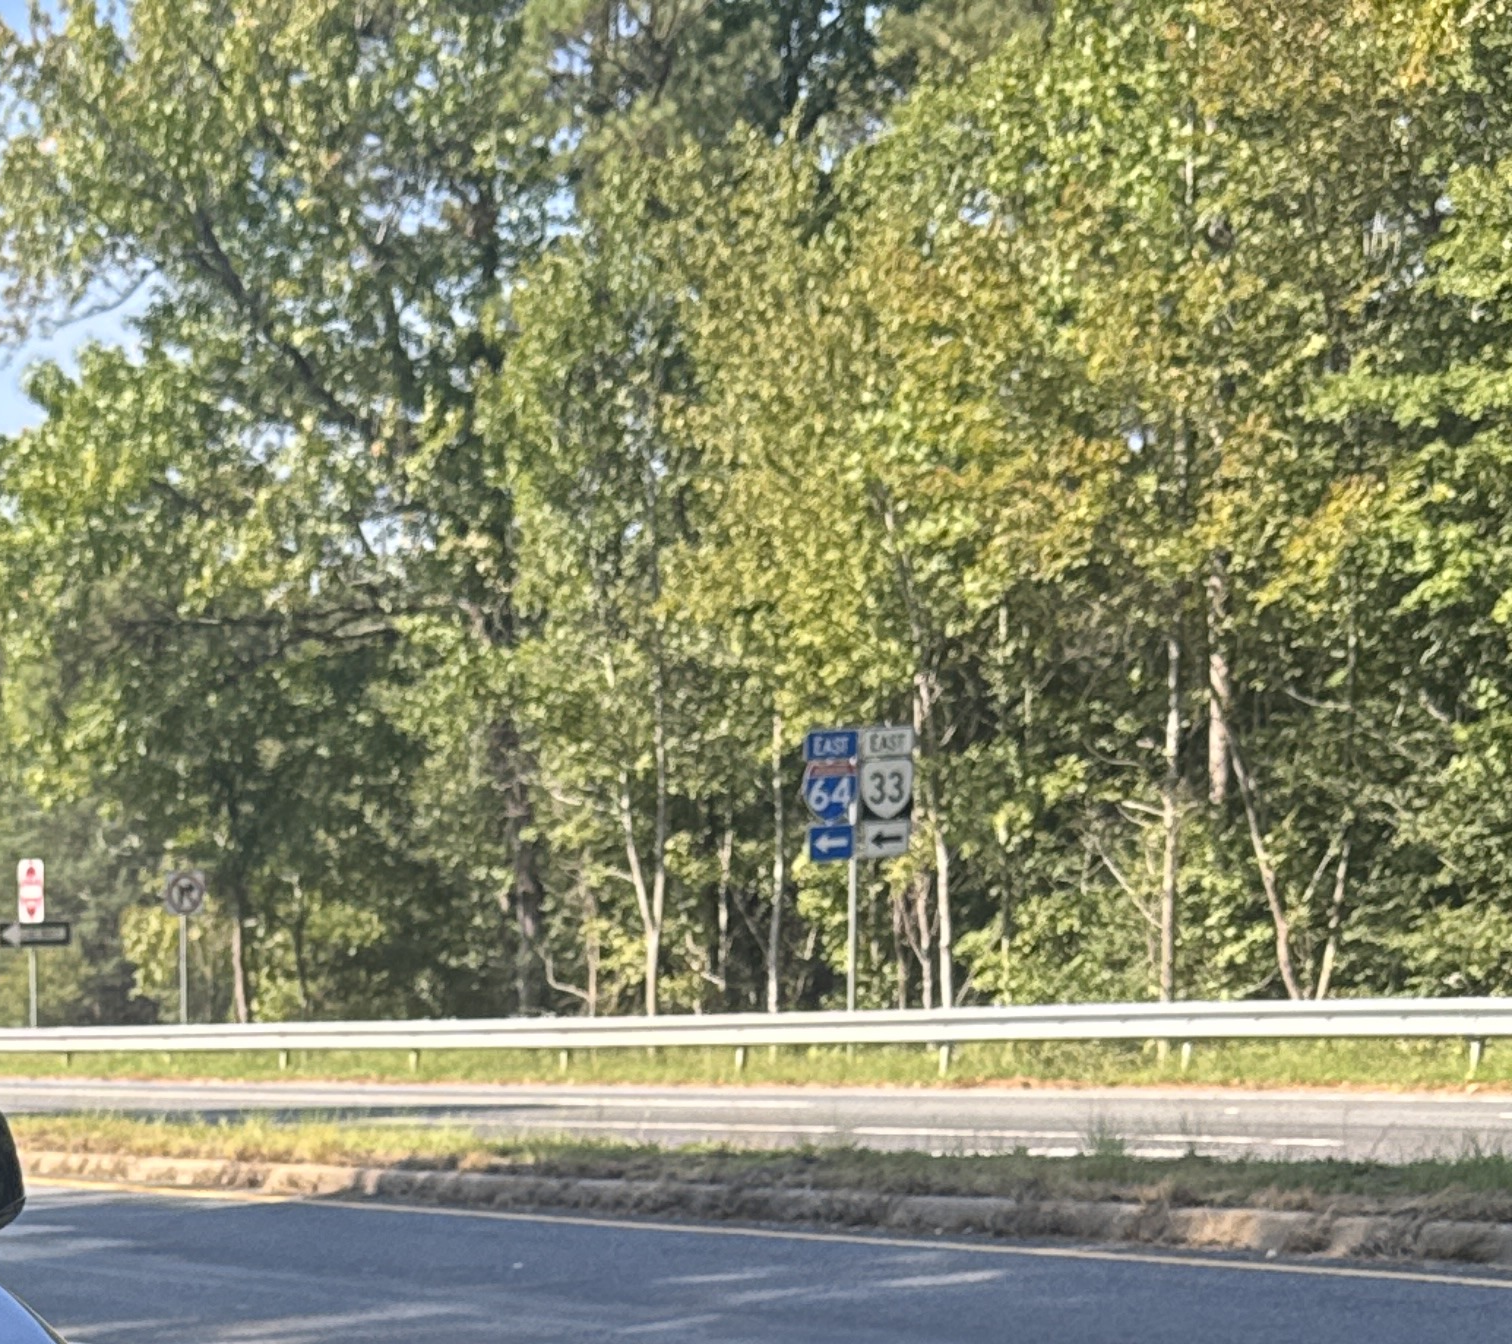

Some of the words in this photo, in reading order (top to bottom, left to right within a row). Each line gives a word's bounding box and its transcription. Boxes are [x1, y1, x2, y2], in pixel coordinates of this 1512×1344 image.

[812, 736, 849, 756] EAST
[870, 733, 905, 753] EAST
[809, 777, 851, 812] 64
[869, 771, 904, 805] 33
